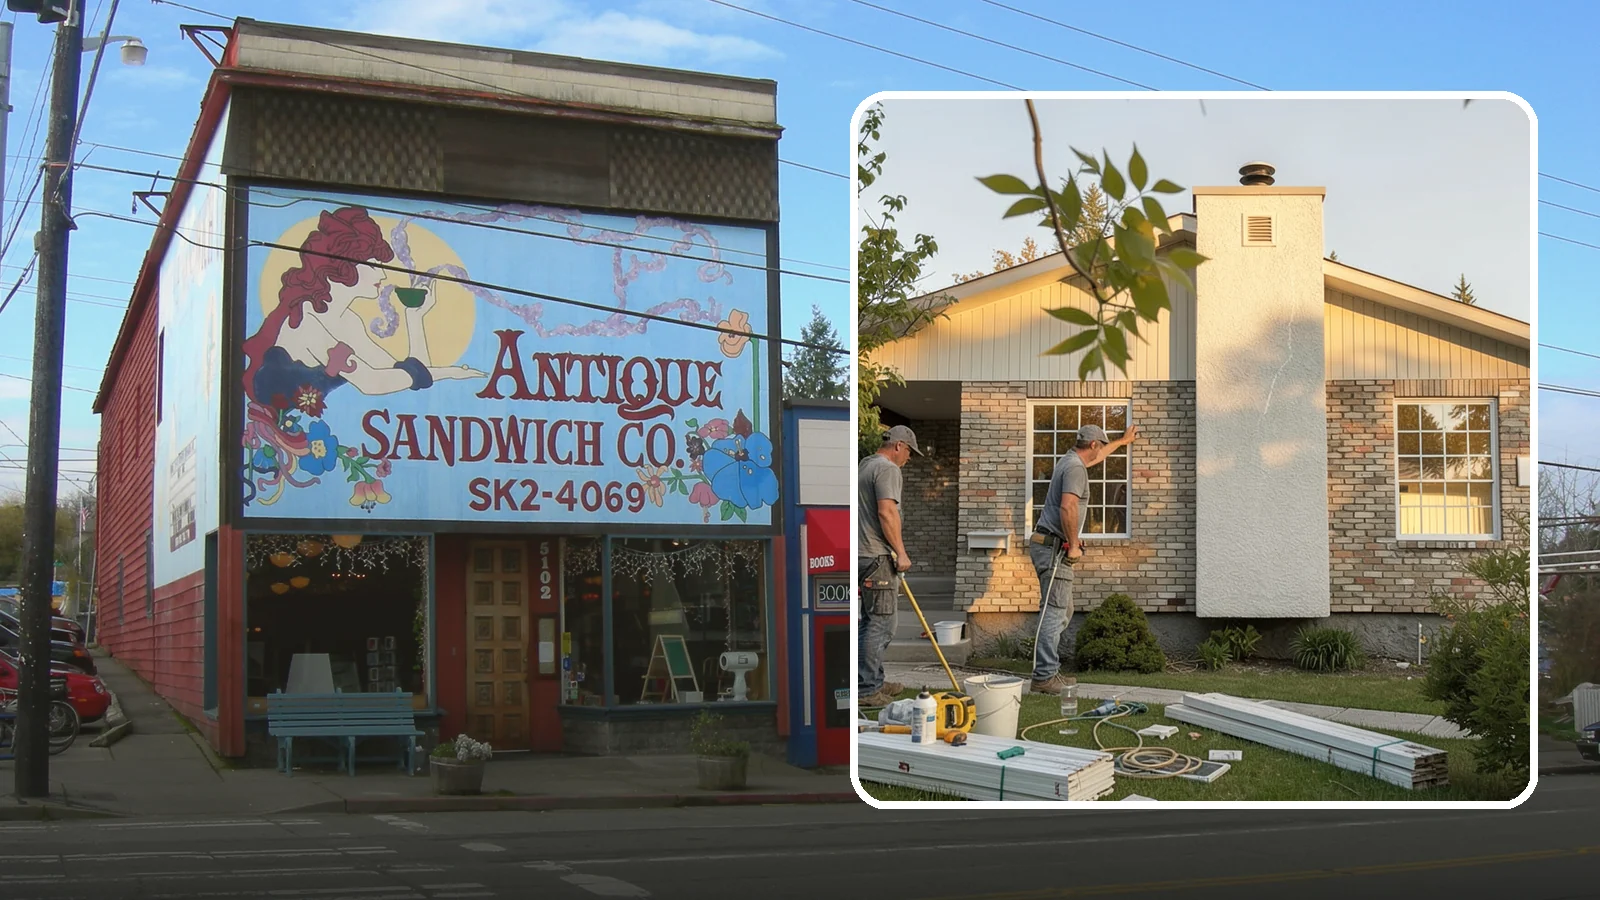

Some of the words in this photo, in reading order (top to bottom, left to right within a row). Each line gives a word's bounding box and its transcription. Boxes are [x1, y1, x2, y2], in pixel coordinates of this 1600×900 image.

[475, 328, 723, 421] ANTIQUE
[361, 408, 605, 468] SANDWICH
[617, 421, 686, 469] CO.
[468, 476, 646, 513] SK2-4069
[539, 541, 552, 600] 5102
[809, 555, 835, 569] BOOKS
